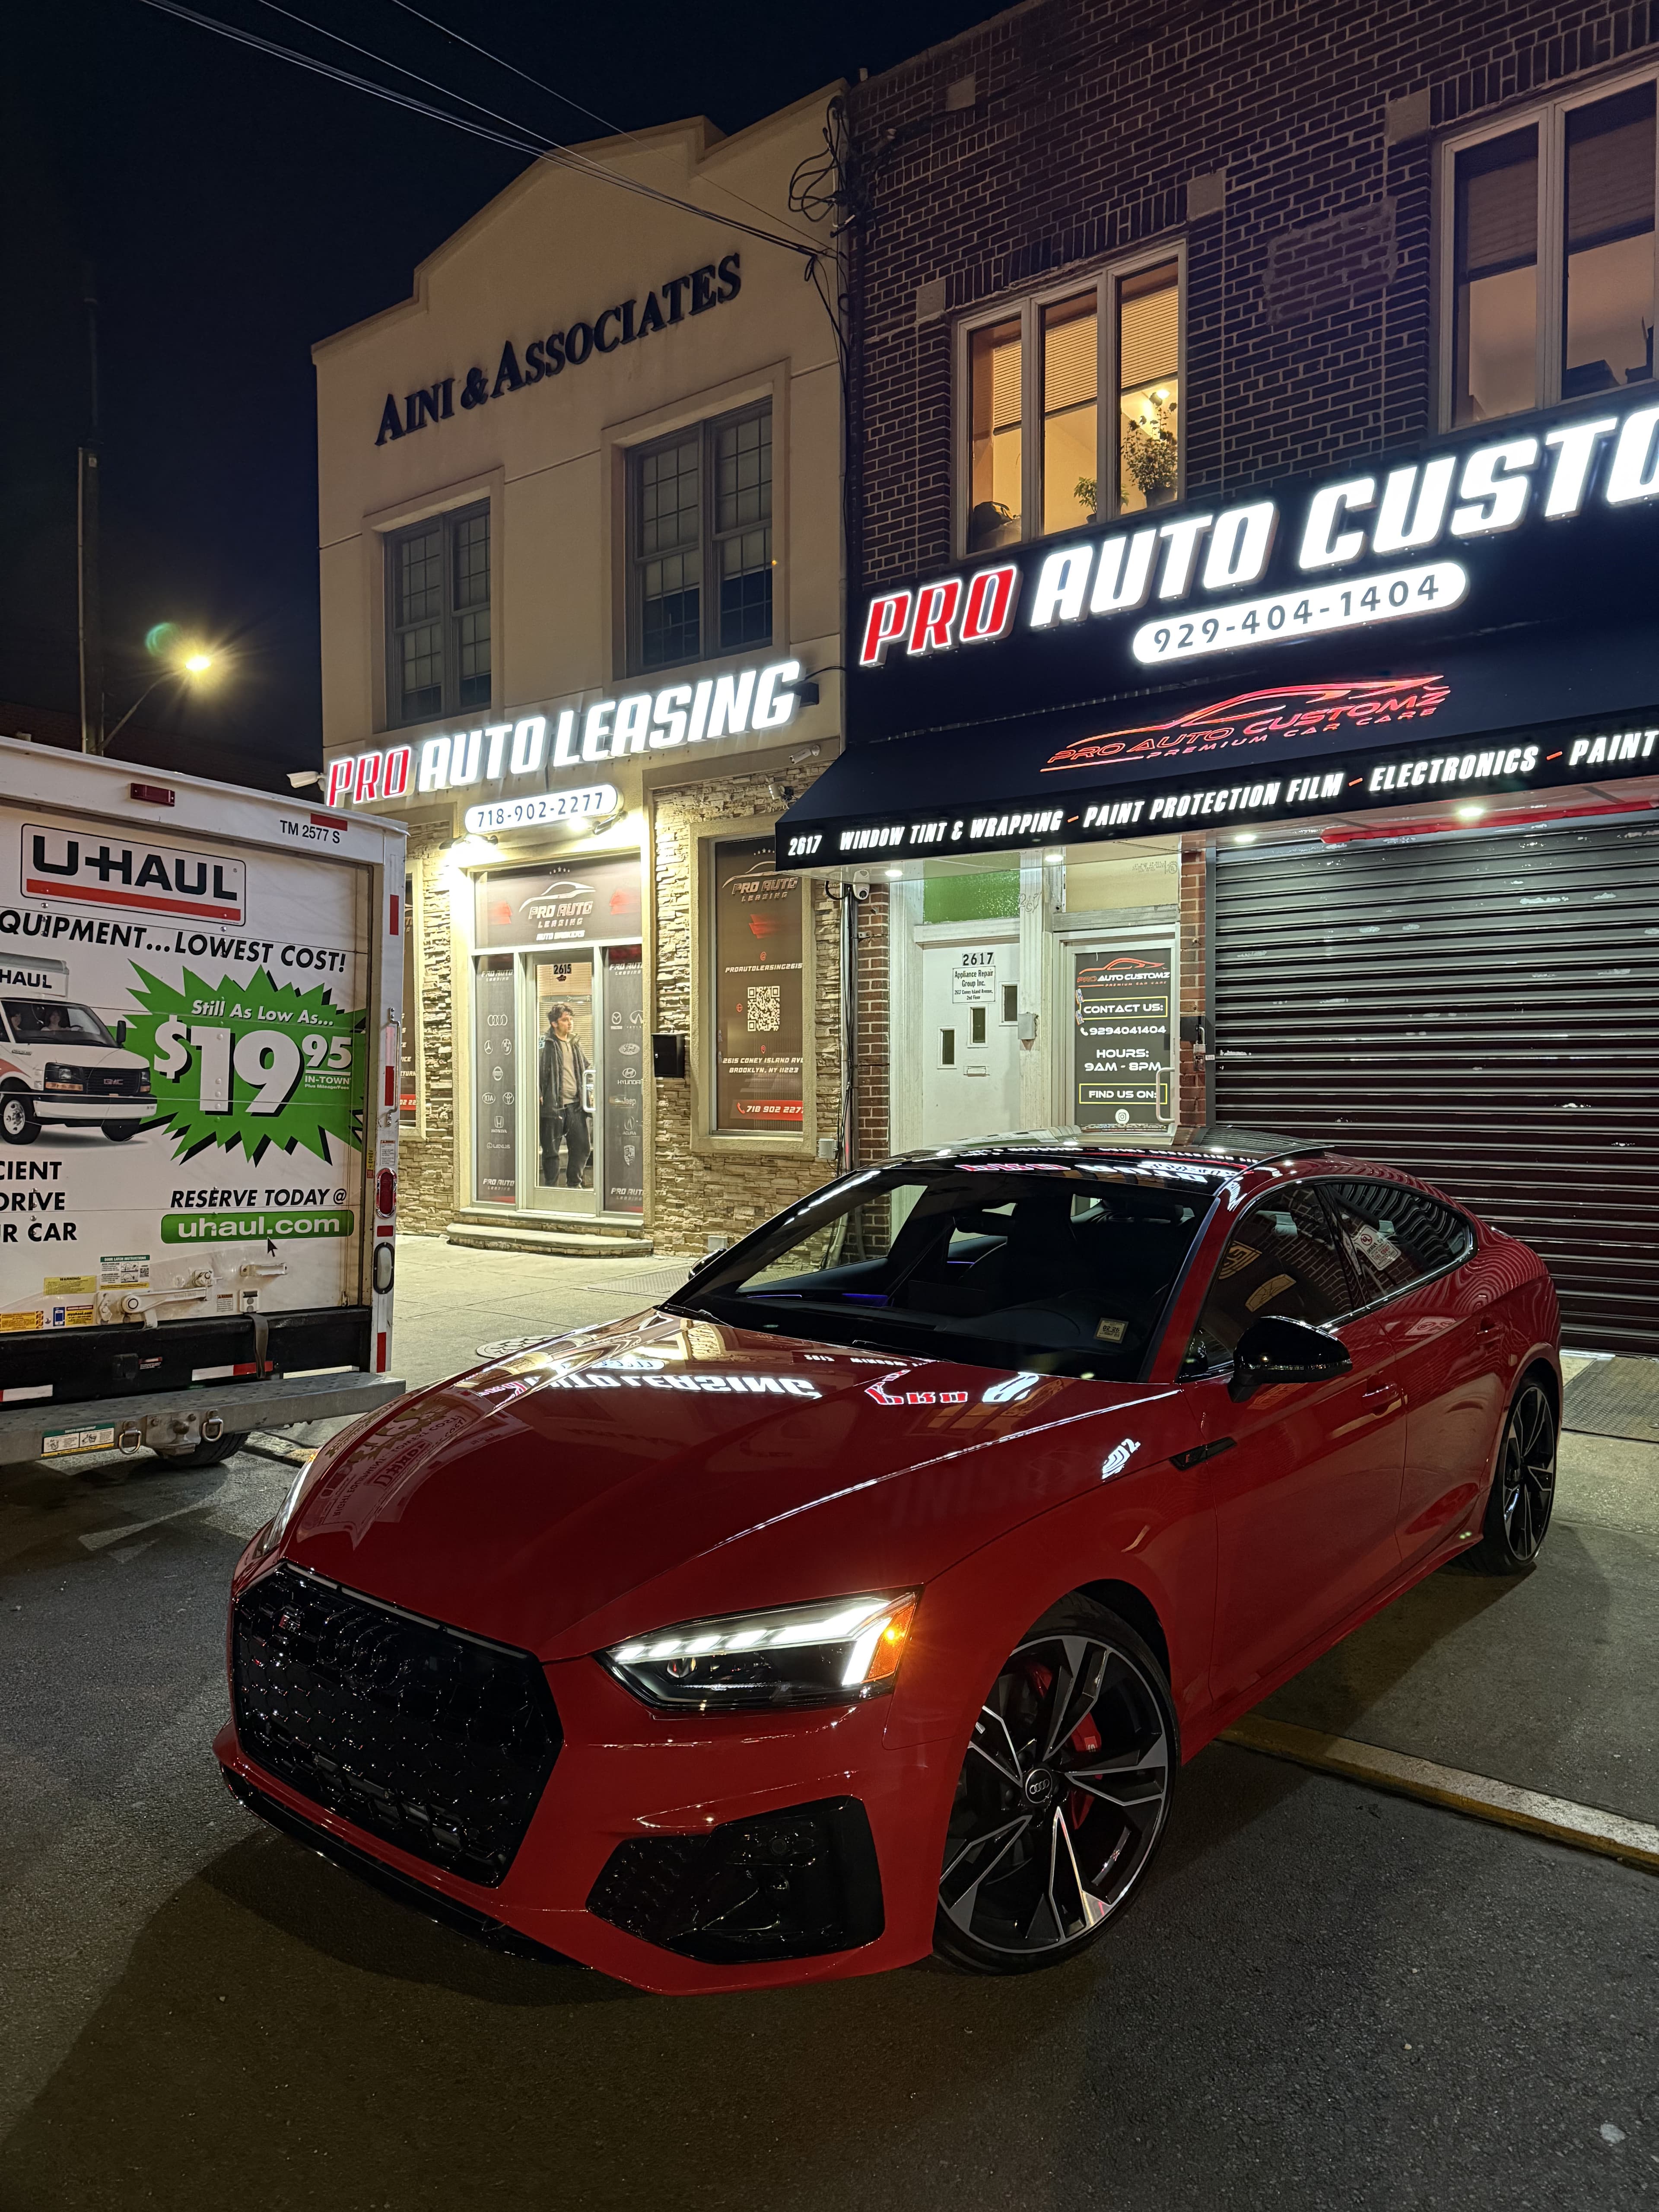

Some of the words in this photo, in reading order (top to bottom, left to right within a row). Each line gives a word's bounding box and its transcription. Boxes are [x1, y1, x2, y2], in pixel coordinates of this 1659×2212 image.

[461, 367, 489, 409] &
[860, 565, 1018, 666] PRO
[1030, 502, 1275, 627] AUTO
[1299, 407, 1659, 569] CUSTO
[1154, 574, 1438, 652] 929-404-1404
[326, 745, 412, 807] PRO
[418, 717, 547, 792] AUTO
[553, 661, 802, 767] LEASING
[1048, 743, 1126, 764] PRO
[1127, 728, 1234, 752] AUTO
[1243, 690, 1450, 735] CUSTOMZ
[1147, 734, 1268, 759] PREMIUM
[1284, 723, 1340, 737] CAR
[1356, 708, 1438, 726] CARE
[788, 835, 822, 856] 2617
[840, 826, 905, 851] WINDOW
[909, 822, 947, 844] TINT
[951, 820, 963, 841] &
[970, 810, 1064, 839] WRAPPING
[1083, 801, 1144, 828] PAINT
[1149, 782, 1281, 820] PROTECTION
[1286, 773, 1344, 802] FILM
[1369, 746, 1539, 792] ELECTRONICS
[1569, 730, 1659, 766] PAINT
[477, 792, 604, 828] 718-902-2277
[280, 820, 299, 836] TM
[302, 825, 330, 842] 2577
[332, 830, 340, 844] S
[33, 835, 238, 901] U-HAUL
[731, 881, 760, 895] PRO
[761, 877, 798, 891] AUTO
[741, 892, 788, 902] LEASING
[528, 905, 556, 919] PRO
[557, 901, 594, 917] AUTO
[538, 918, 583, 928] LEASING
[175, 931, 274, 964] LOWEST
[281, 945, 346, 973] COST!
[963, 952, 994, 966] 2617
[553, 963, 572, 975] 2615
[725, 963, 803, 973] PROAUTOLEASING2615
[955, 970, 977, 979] Appliance
[978, 969, 993, 978] Repair
[1124, 972, 1170, 981] CUSTOMZ
[962, 979, 976, 988] Group
[191, 998, 225, 1017] Still
[229, 1004, 252, 1020] As
[258, 1007, 294, 1022] Low
[298, 1009, 334, 1027] As...
[1084, 1004, 1140, 1014] CONTACT
[1143, 1004, 1163, 1012] US:
[1089, 1026, 1166, 1036] 9294041404
[1096, 1049, 1149, 1058] HOURS:
[1084, 1062, 1118, 1071] 9AM
[1129, 1062, 1162, 1071] 8PM
[170, 1189, 258, 1208] RESERVE
[264, 1188, 331, 1207] TODAY
[334, 1188, 347, 1205] @
[0, 1224, 18, 1243] R
[28, 1222, 77, 1242] CAR
[178, 1216, 340, 1238] uhaul.com
